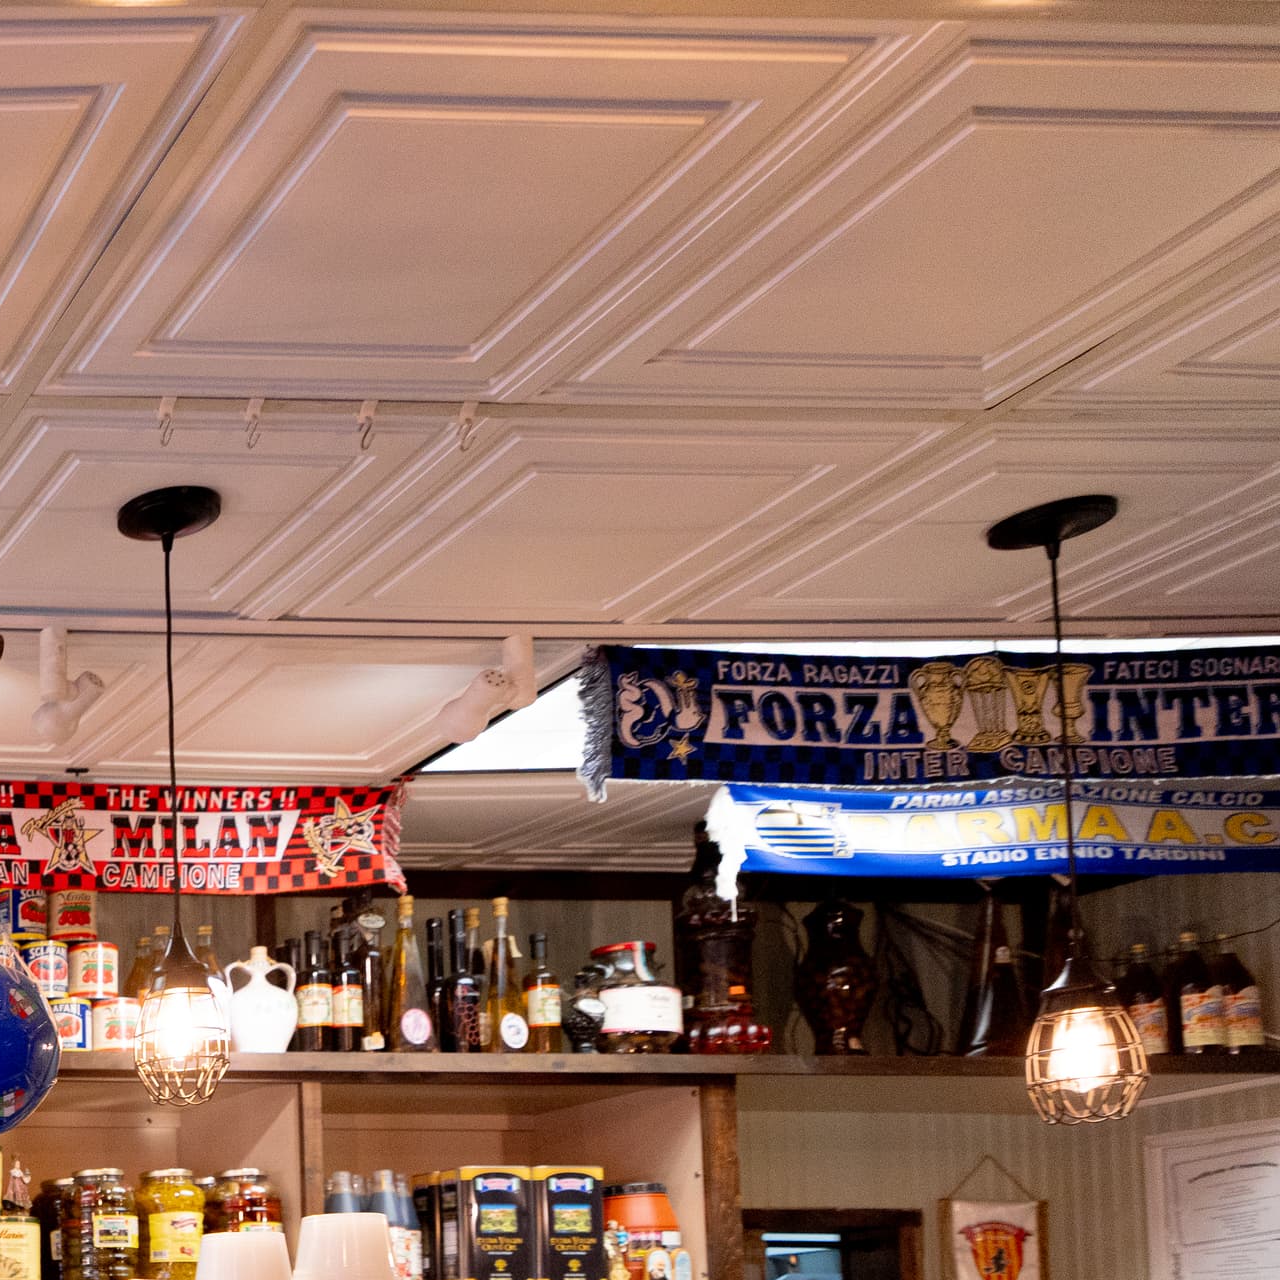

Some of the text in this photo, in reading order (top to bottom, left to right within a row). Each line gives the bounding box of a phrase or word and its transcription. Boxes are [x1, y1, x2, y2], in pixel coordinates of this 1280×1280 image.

[717, 660, 900, 684] FORZA RAGAZZI
[1103, 659, 1179, 680] FATECI
[714, 690, 924, 744] FORZA
[864, 752, 970, 780] INTER
[1000, 746, 1179, 775] CAMPIONE
[106, 788, 150, 808] THE
[164, 789, 271, 809] WINNERS
[890, 791, 979, 810] PARMA
[1170, 787, 1264, 806] CALCIO
[111, 814, 282, 858] MILAN
[848, 801, 1132, 847] PARMA
[941, 848, 1029, 867] STADIO
[1123, 847, 1227, 861] TARDINI
[102, 864, 240, 889] CAMPIONE
